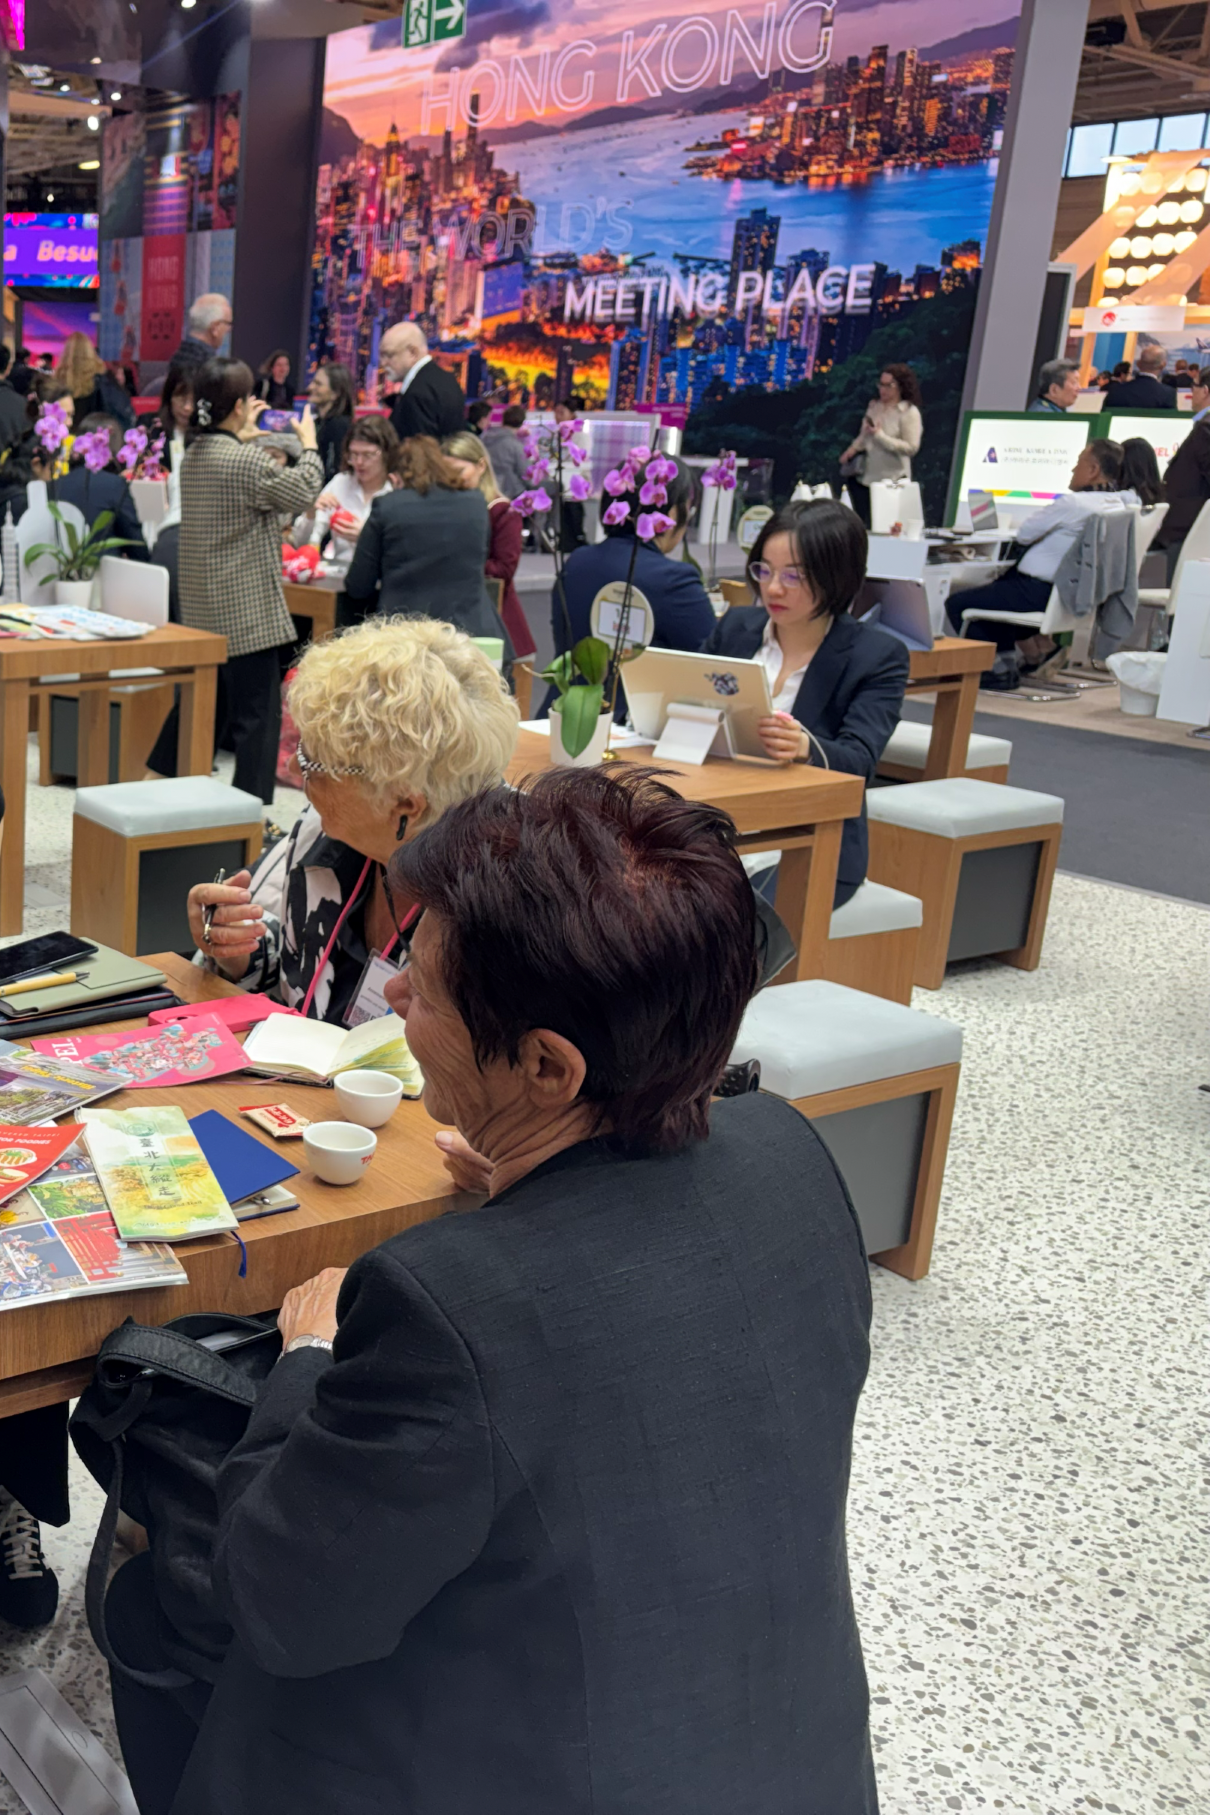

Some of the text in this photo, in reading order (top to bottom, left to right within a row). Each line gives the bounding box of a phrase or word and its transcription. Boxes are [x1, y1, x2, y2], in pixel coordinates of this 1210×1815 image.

[420, 0, 838, 135] HONG KONG
[37, 240, 98, 262] Besu
[432, 198, 634, 261] WORLD'S
[563, 262, 876, 321] MEETING PLACE
